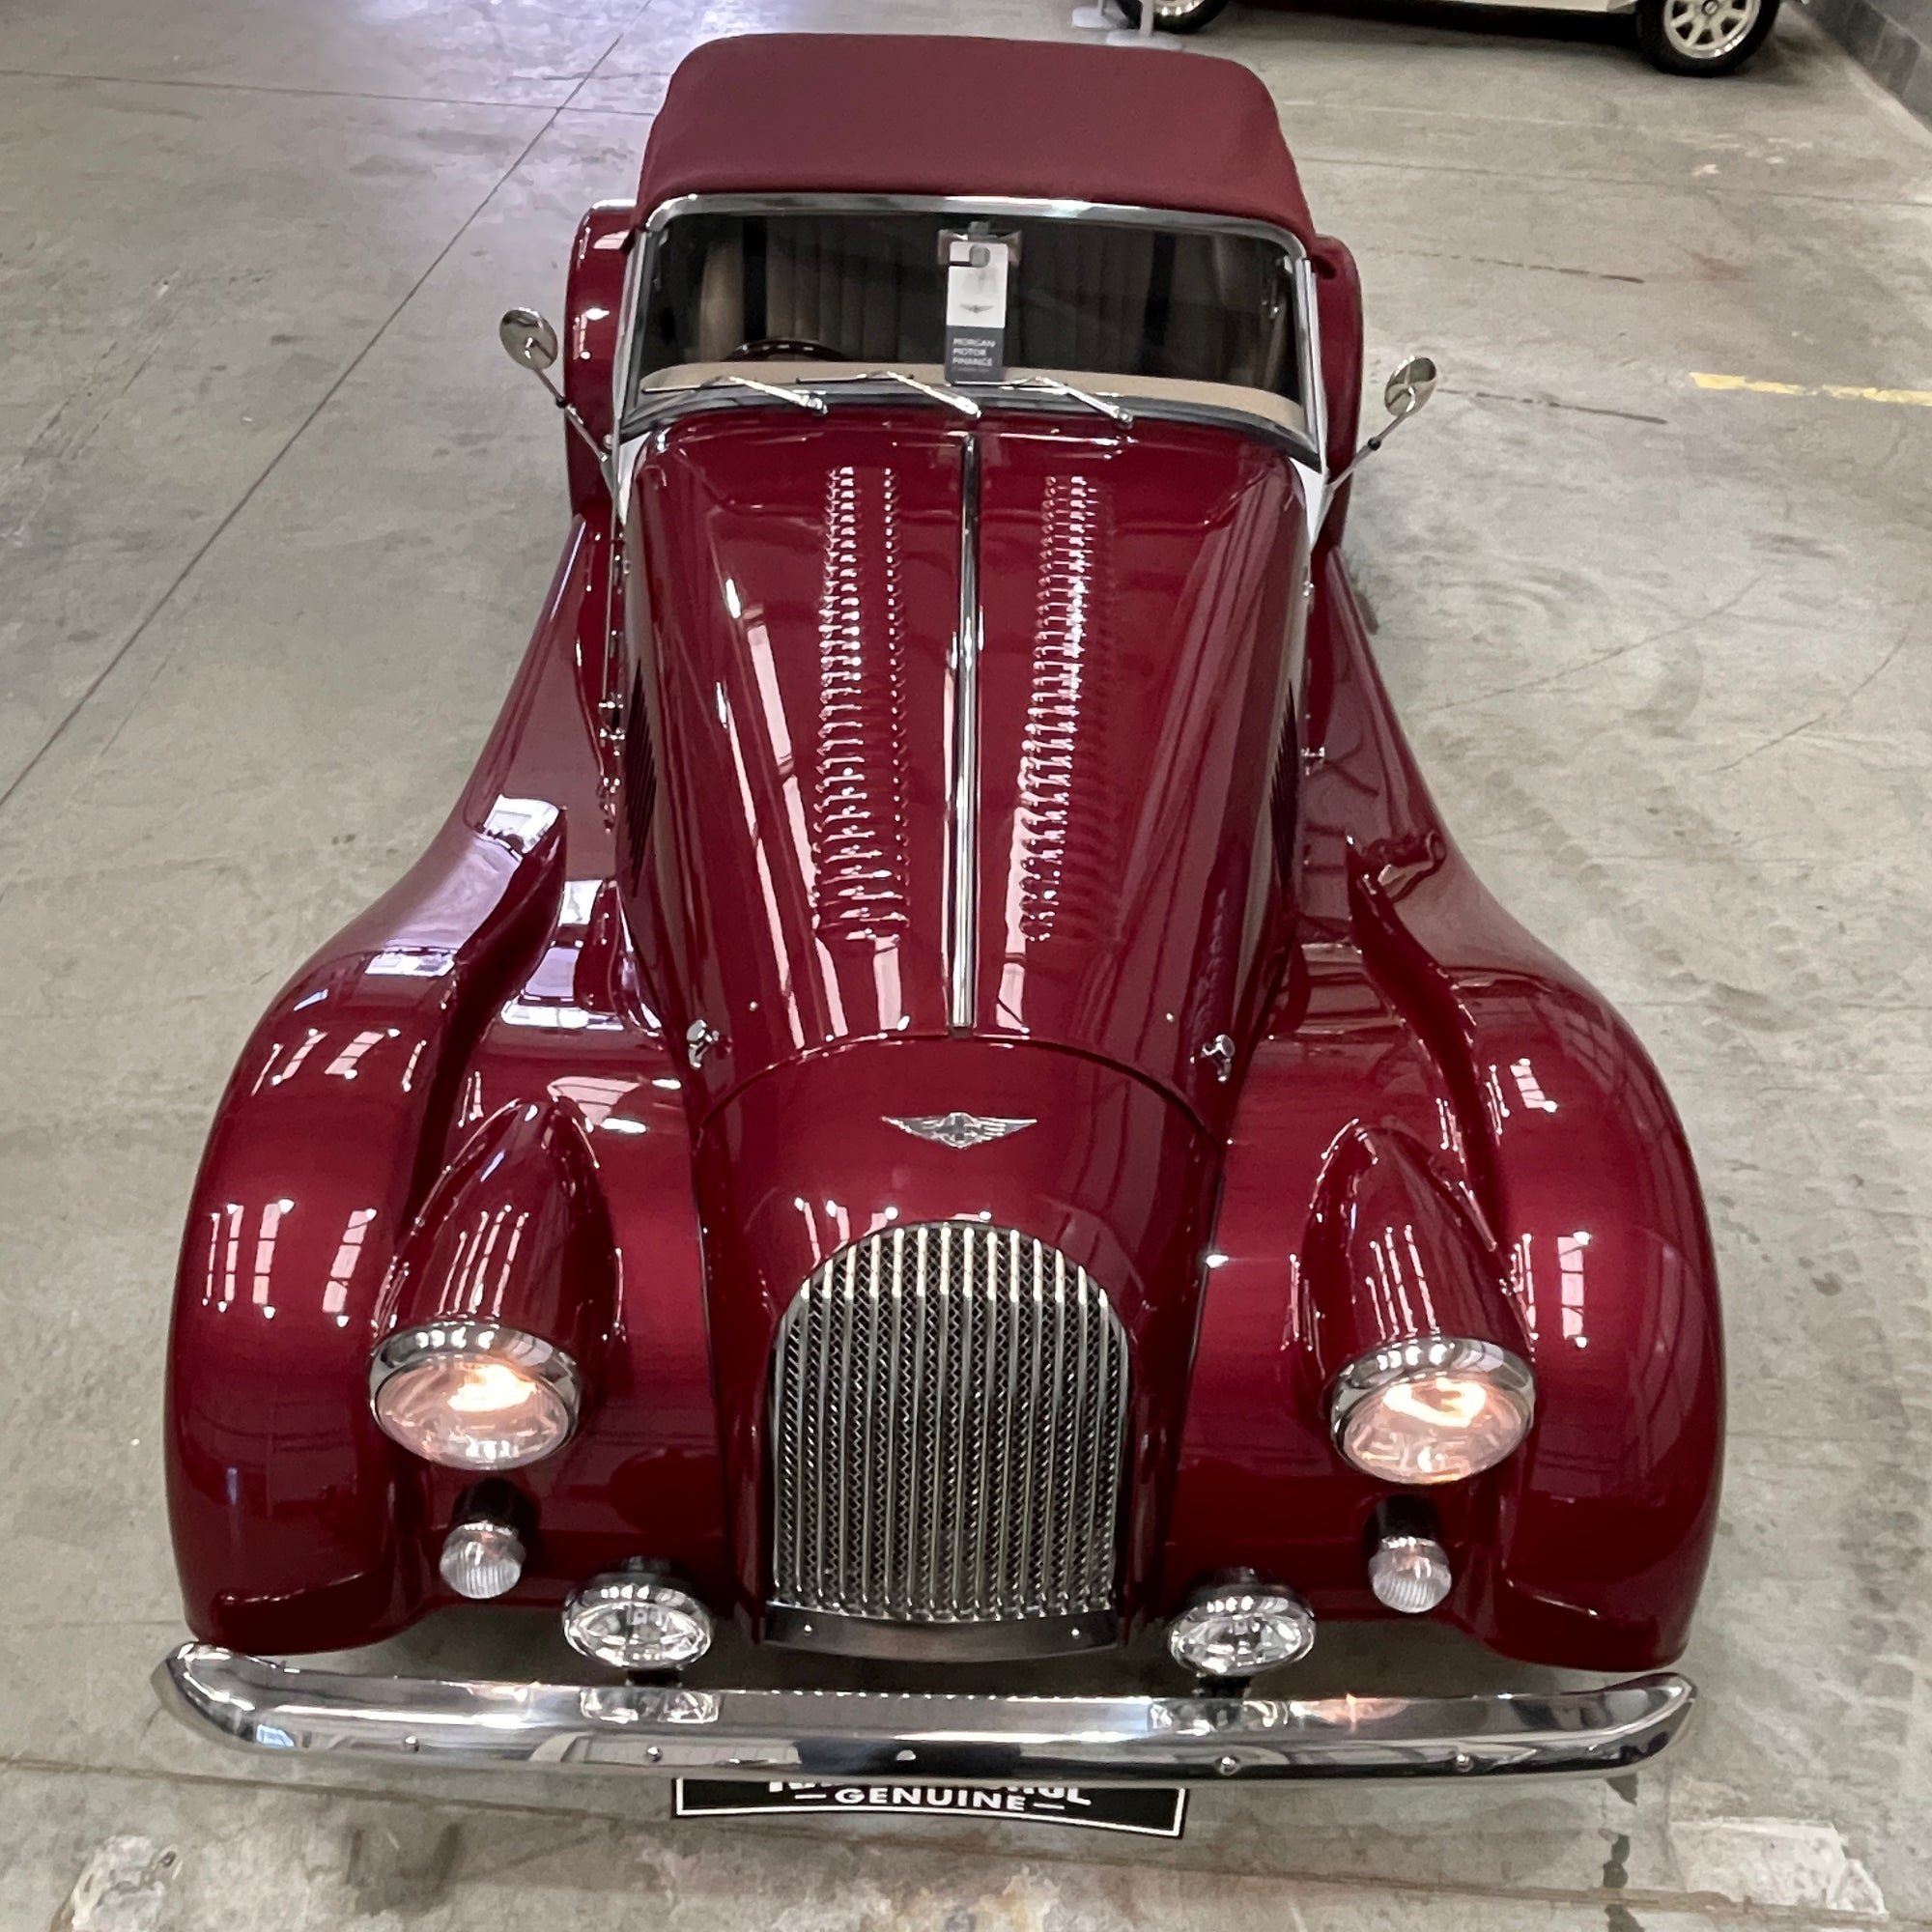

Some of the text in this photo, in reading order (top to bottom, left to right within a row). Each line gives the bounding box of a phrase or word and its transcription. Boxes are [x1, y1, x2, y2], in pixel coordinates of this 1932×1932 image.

[952, 338, 996, 348] MORGAN
[952, 348, 986, 356] MOTOR
[835, 1787, 1026, 1811] GENUINE
